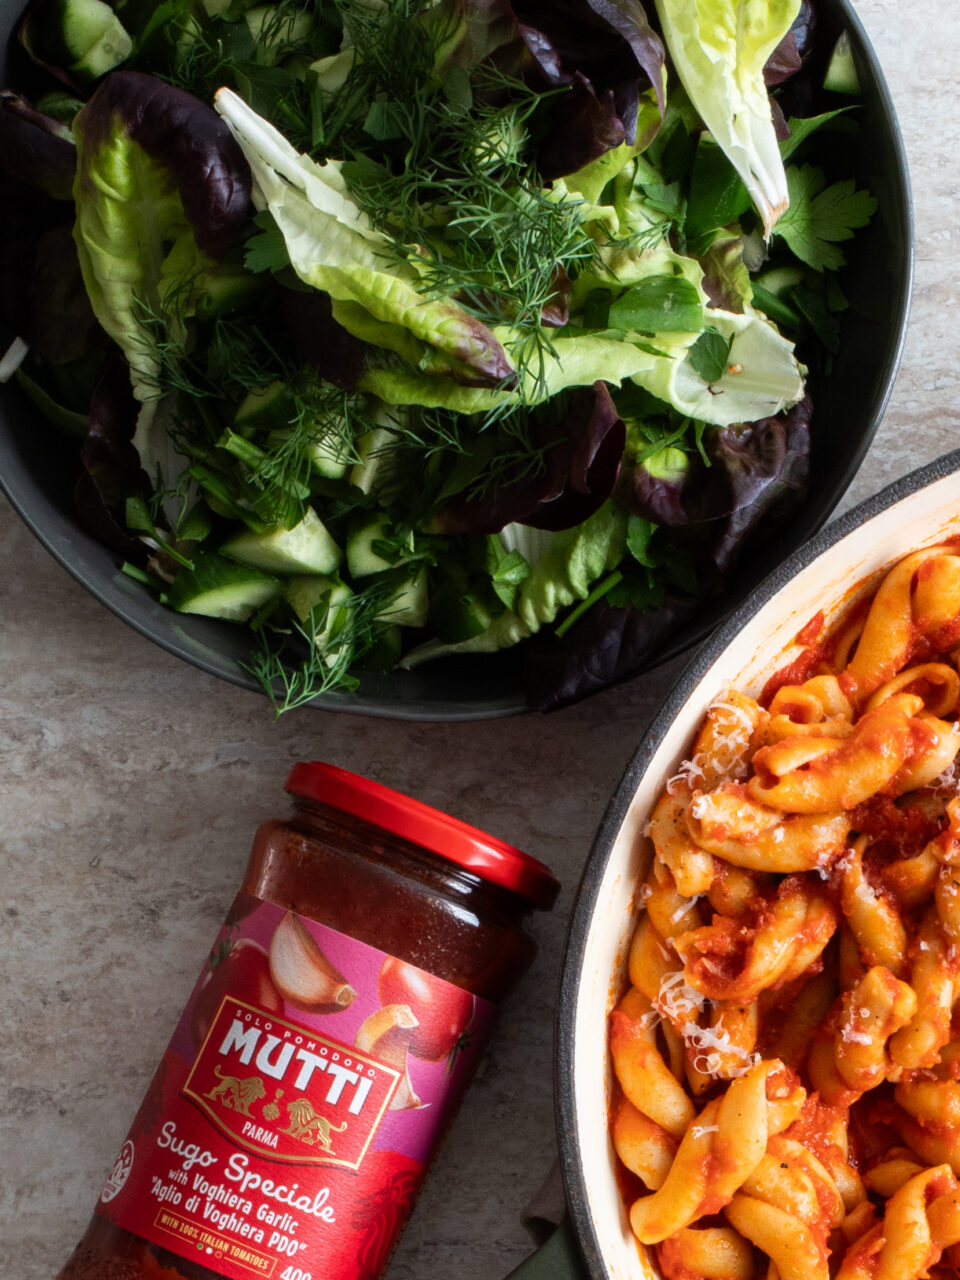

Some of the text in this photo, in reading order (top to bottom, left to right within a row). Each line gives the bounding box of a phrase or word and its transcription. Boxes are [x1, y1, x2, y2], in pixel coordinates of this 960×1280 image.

[236, 1009, 272, 1030] SOLO
[219, 1019, 373, 1115] MUTTI
[242, 1121, 279, 1148] PARMA
[157, 1121, 336, 1223] Sugo Speciale
[168, 1169, 298, 1234] with Voghiera Garlic
[185, 1194, 200, 1213] di
[203, 1202, 264, 1243] Voghiera
[161, 1214, 268, 1270] WITH 100% ITALIAN TOMATOES
